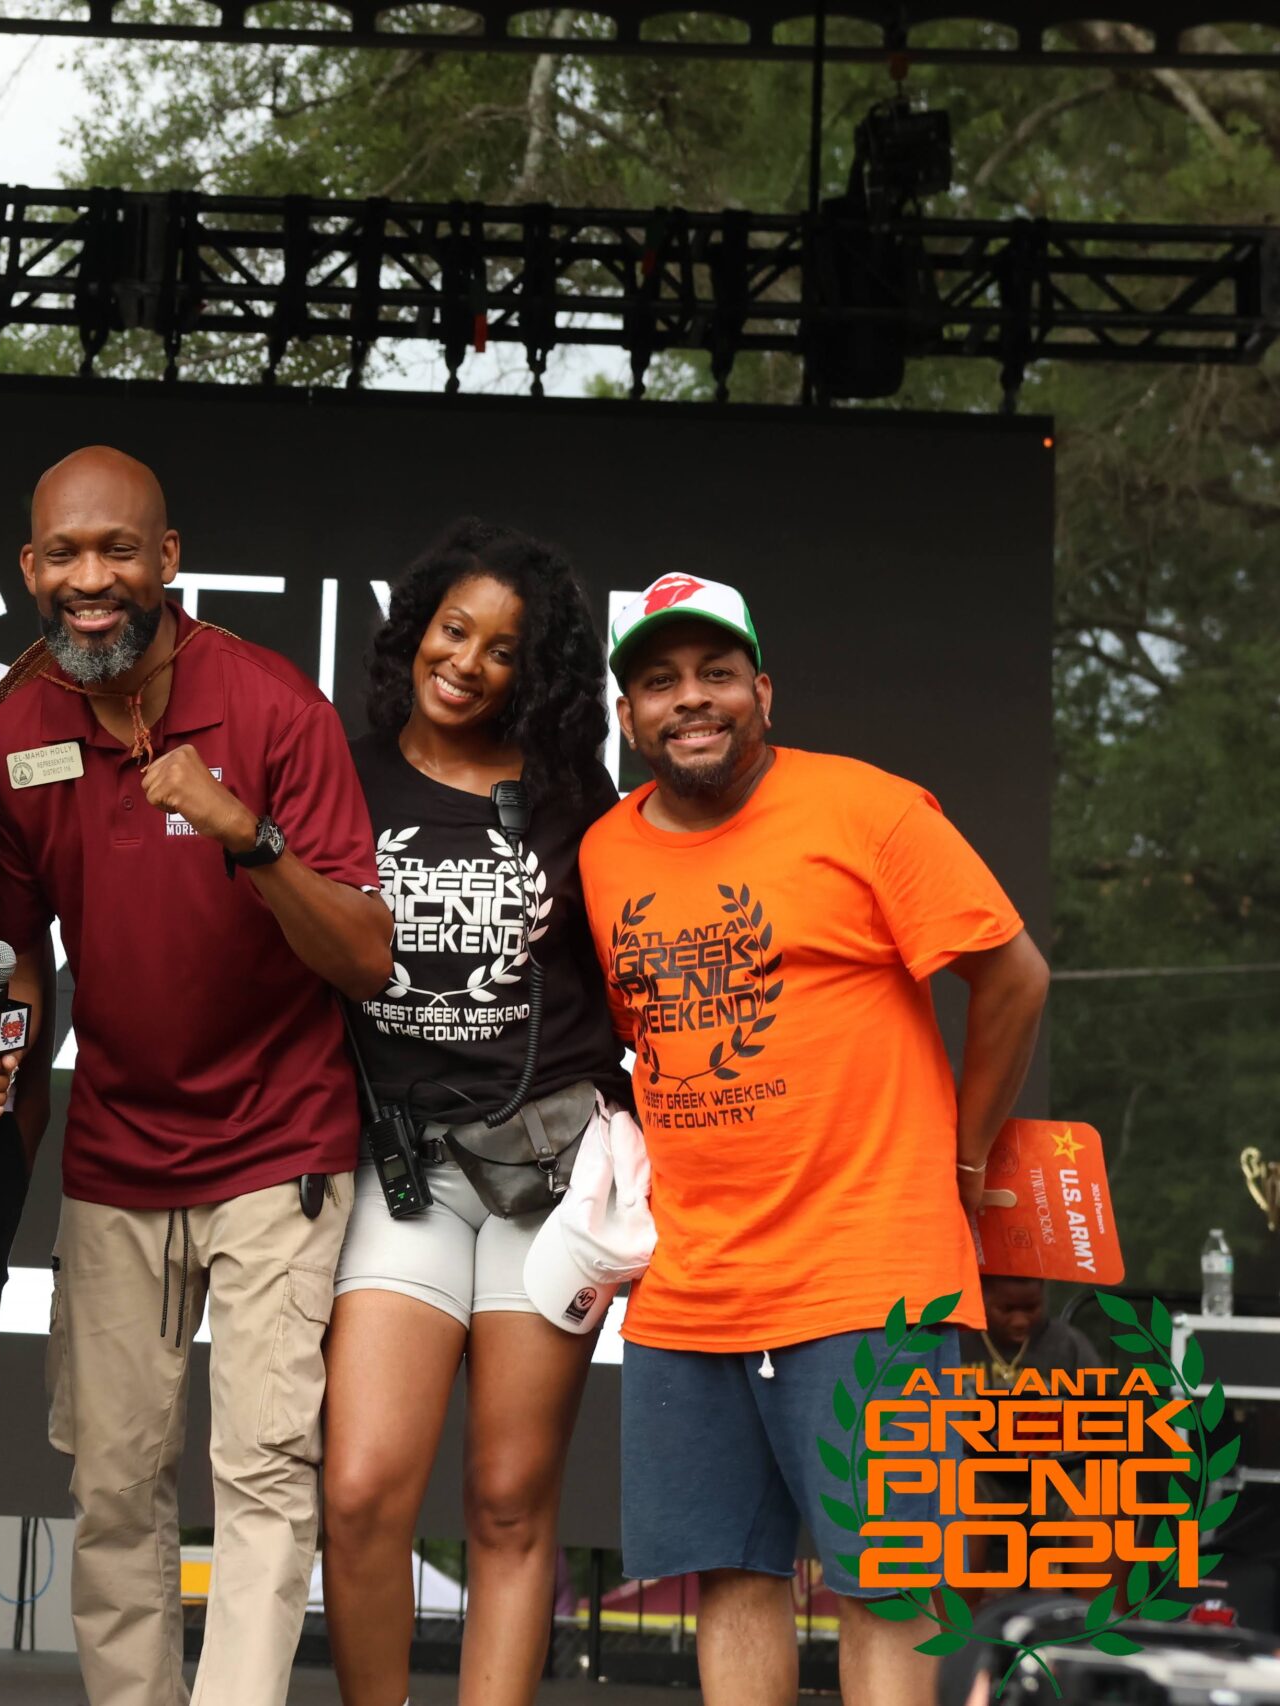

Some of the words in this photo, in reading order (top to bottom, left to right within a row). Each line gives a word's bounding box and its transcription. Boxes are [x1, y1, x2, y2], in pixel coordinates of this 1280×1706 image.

[50, 744, 73, 756] HOLLY
[378, 856, 525, 873] ATLANTA
[377, 870, 530, 898] GREEK
[390, 923, 526, 956] EEKEND
[625, 920, 739, 950] ATLANTA
[615, 934, 754, 979] GREEK
[611, 962, 756, 1006] PICNIC
[362, 1001, 382, 1018] THE
[382, 1003, 413, 1022] BEST
[415, 1006, 461, 1024] GREEK
[464, 1003, 531, 1025] WEEKEND
[376, 1019, 391, 1035] IN
[391, 1022, 421, 1039] THE
[423, 1025, 504, 1042] COUNTRY
[666, 1092, 708, 1110] GREEK
[710, 1078, 787, 1107] WEEKEND
[652, 1112, 671, 1129] THE
[674, 1105, 756, 1129] COUNTRY
[1059, 1169, 1082, 1207] U.S.
[1066, 1209, 1097, 1274] ARMY
